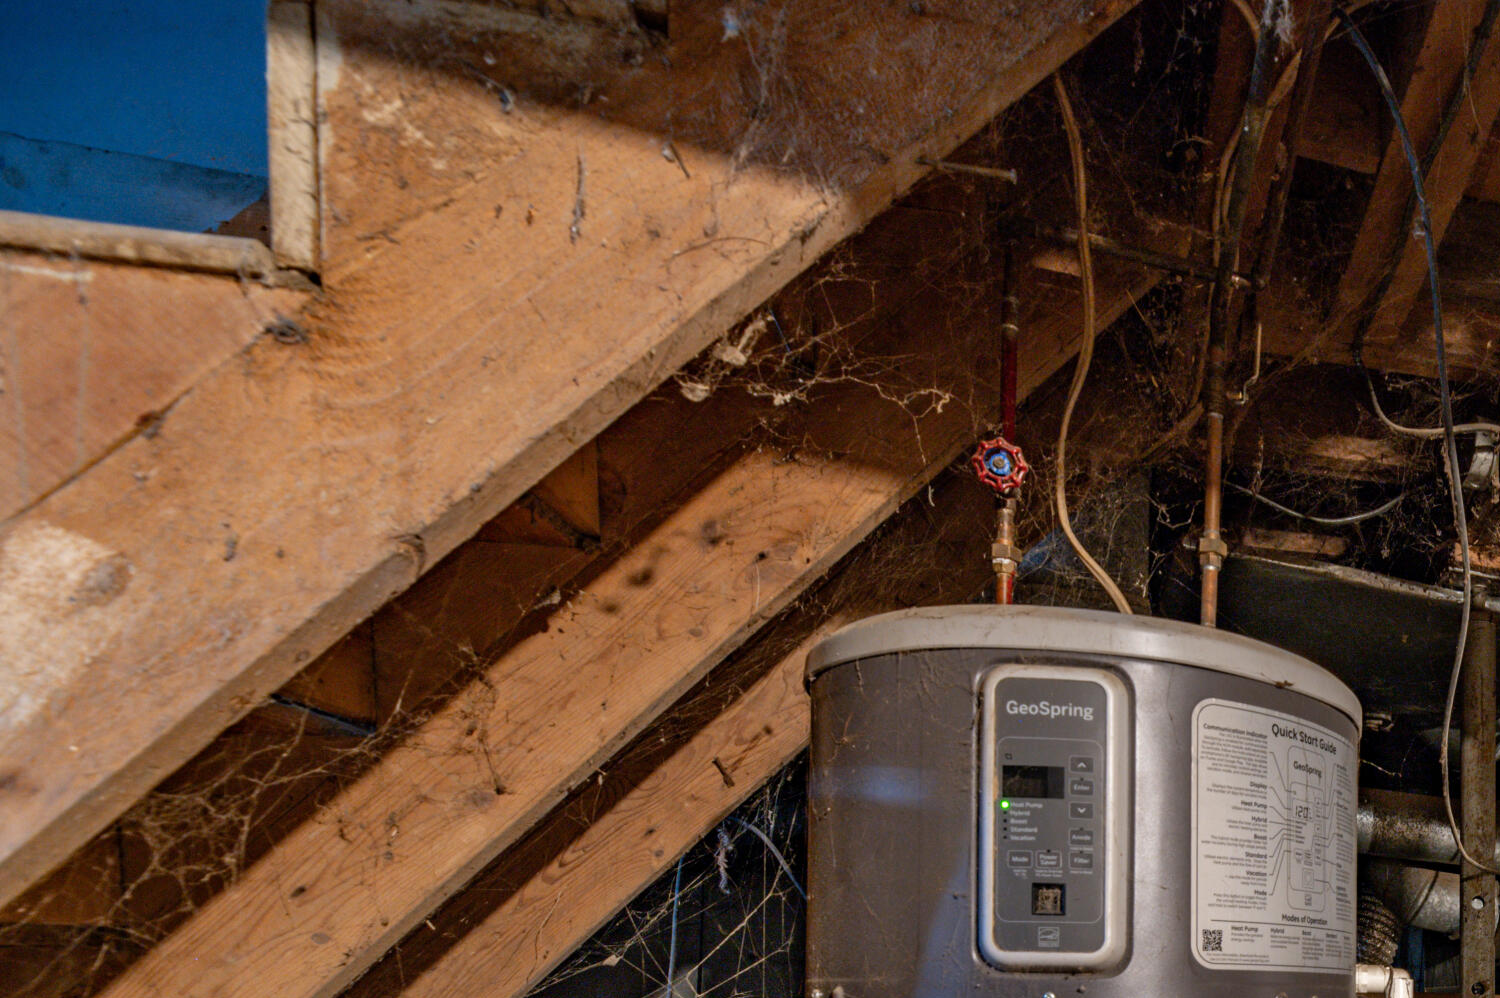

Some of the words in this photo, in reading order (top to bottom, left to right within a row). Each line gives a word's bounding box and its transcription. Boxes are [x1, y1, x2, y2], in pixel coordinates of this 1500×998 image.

[1006, 700, 1094, 721] GeoSpring
[1271, 723, 1298, 741] Quick
[1300, 731, 1319, 748] Start
[1319, 738, 1337, 755] Guide
[1293, 760, 1322, 779] GeoSpring
